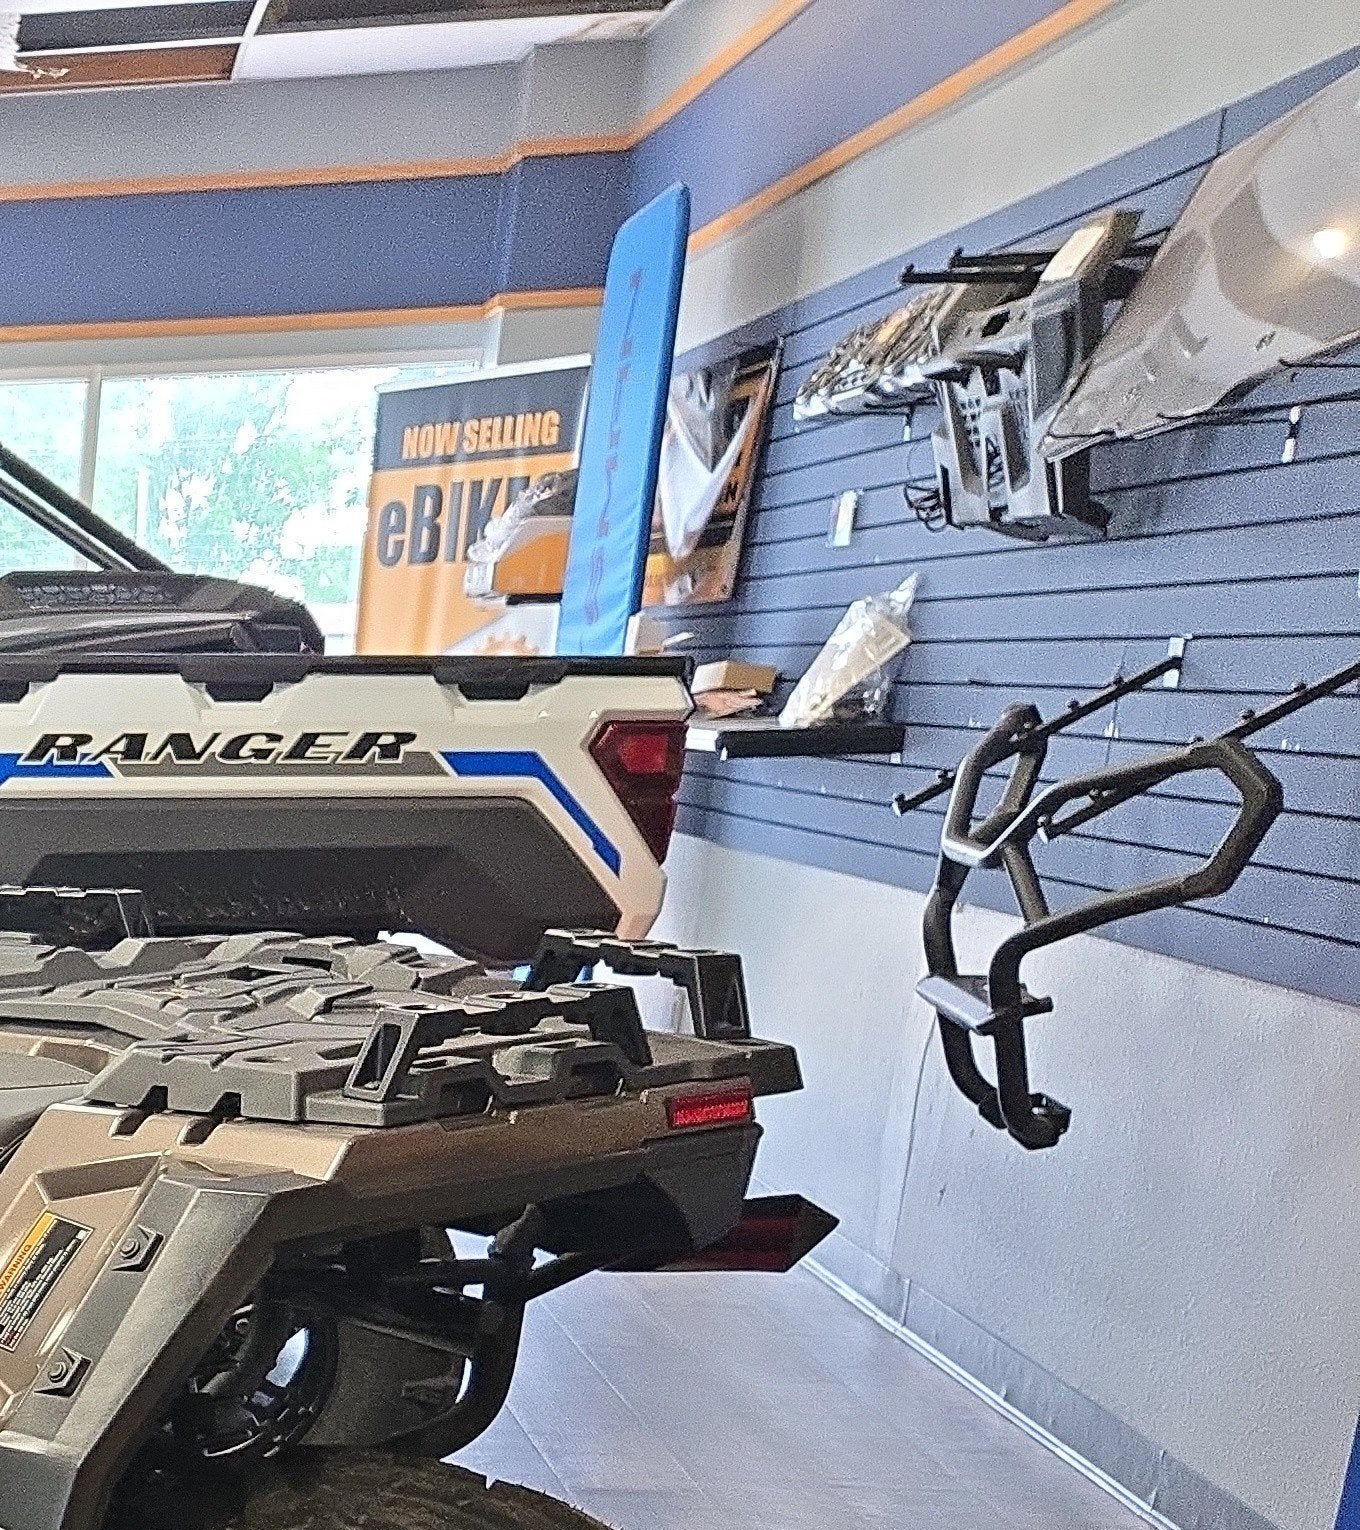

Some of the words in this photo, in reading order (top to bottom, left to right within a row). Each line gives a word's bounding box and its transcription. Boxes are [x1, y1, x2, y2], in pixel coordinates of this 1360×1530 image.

[402, 421, 460, 459] NOW
[462, 410, 560, 454] SELLING
[377, 475, 532, 567] eBIK
[17, 731, 418, 766] RANGER
